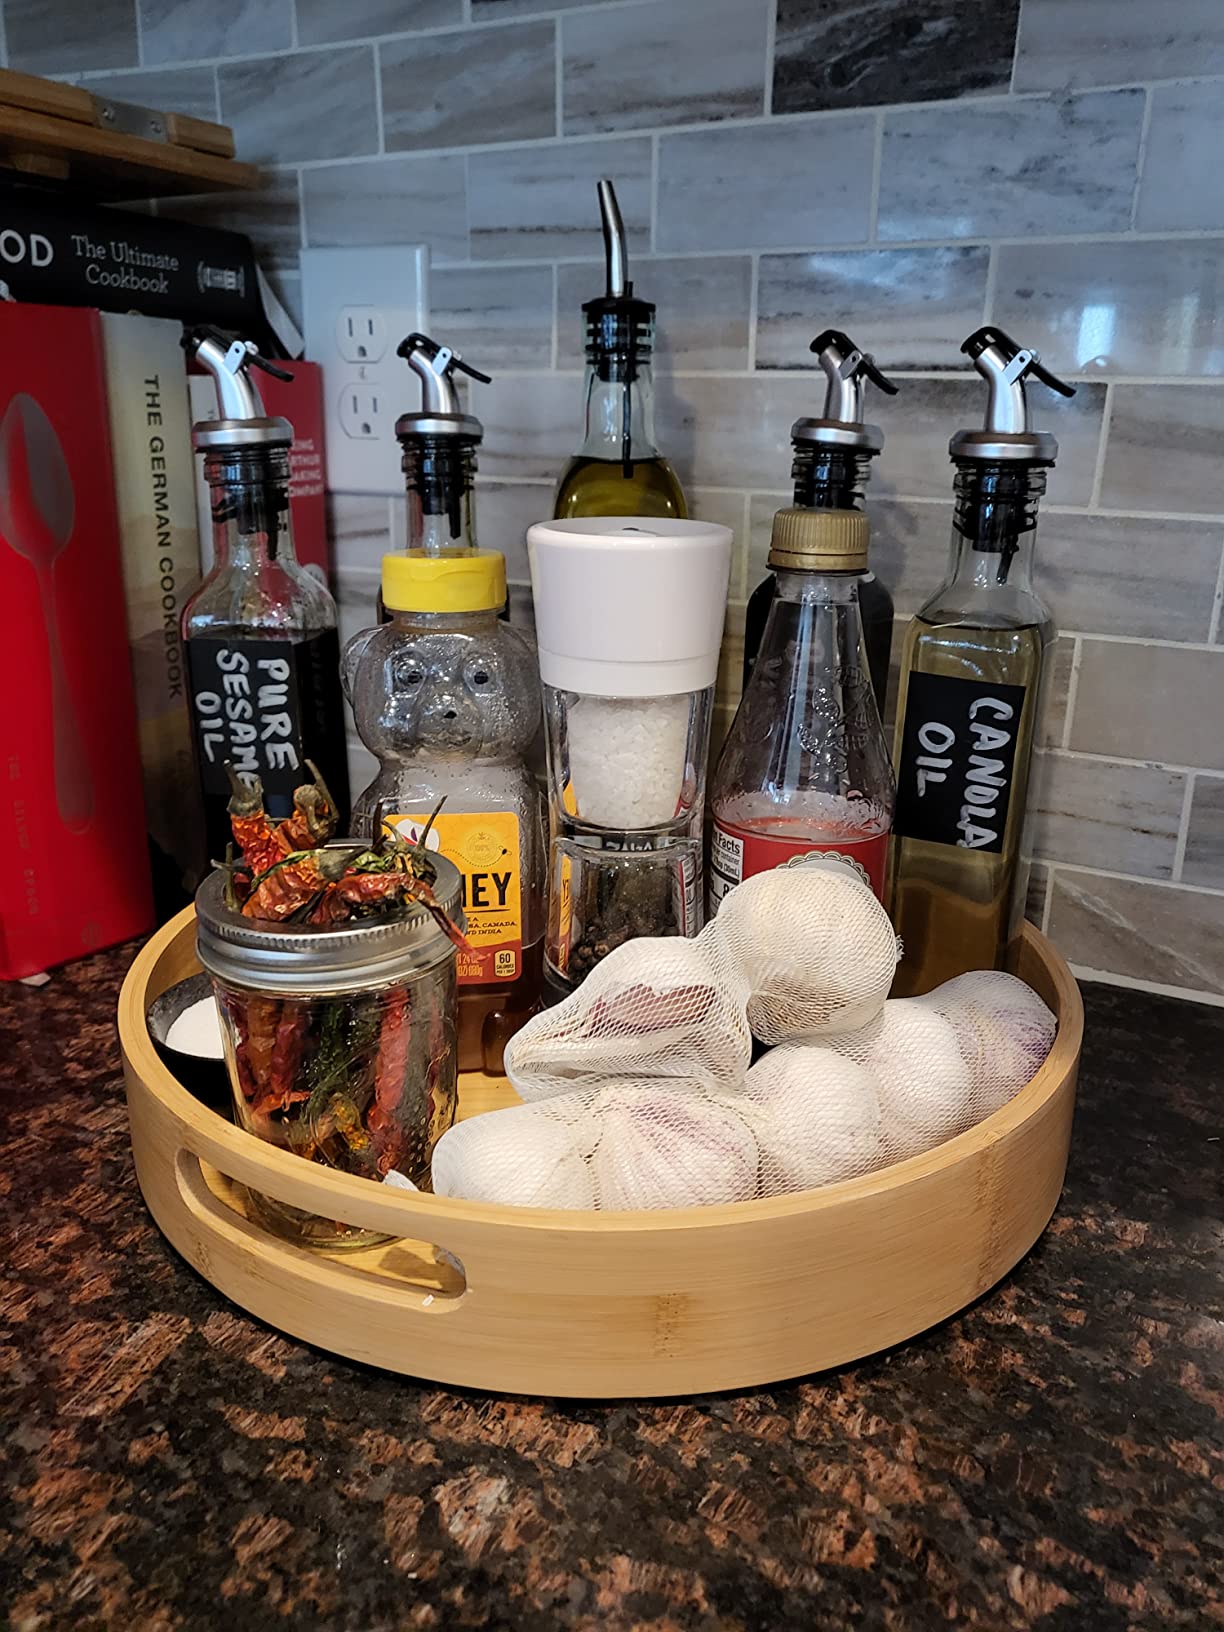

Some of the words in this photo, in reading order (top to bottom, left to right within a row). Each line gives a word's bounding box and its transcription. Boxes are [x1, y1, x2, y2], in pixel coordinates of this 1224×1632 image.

[0, 229, 54, 267] OD
[71, 234, 106, 260] The
[110, 241, 179, 271] Ultimate
[85, 263, 169, 293] Cookbook
[144, 374, 163, 426] THE
[149, 436, 172, 546] GERMAN
[159, 557, 182, 699] COOKBOOK
[195, 691, 225, 763] OIL
[257, 658, 300, 771] PURE
[915, 721, 955, 797] OIL
[956, 697, 1013, 848] CANOLA
[718, 833, 740, 854] Facts
[499, 952, 511, 964] 60
